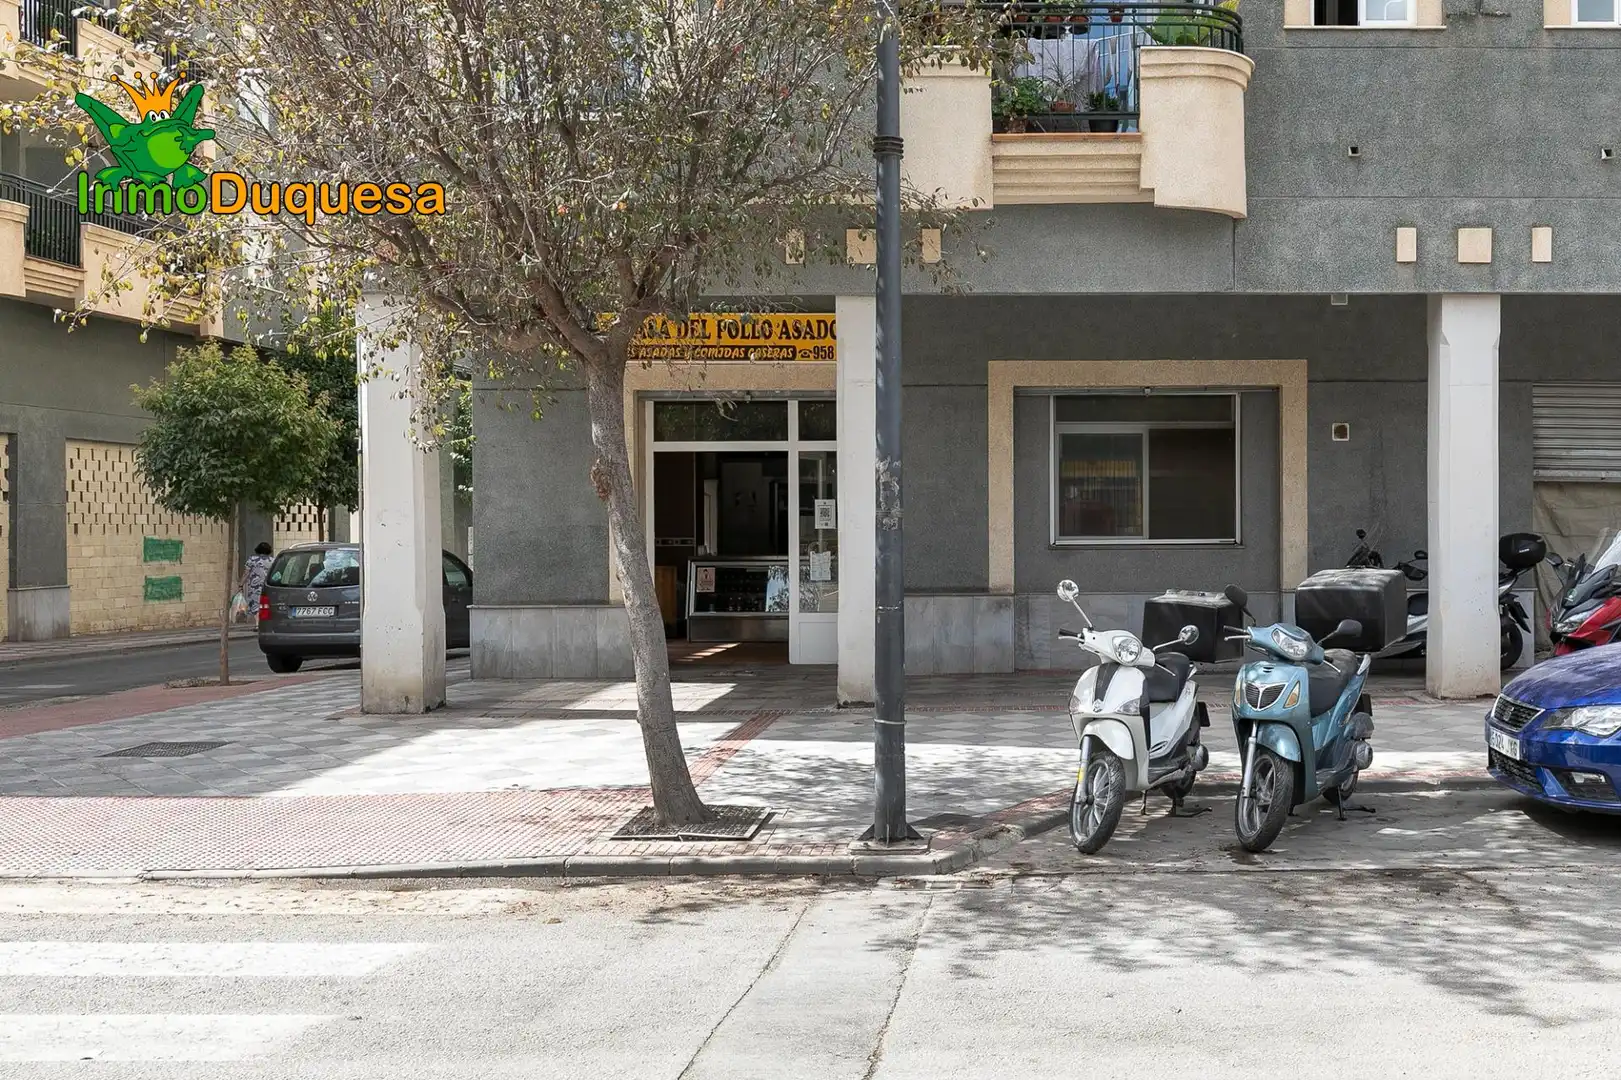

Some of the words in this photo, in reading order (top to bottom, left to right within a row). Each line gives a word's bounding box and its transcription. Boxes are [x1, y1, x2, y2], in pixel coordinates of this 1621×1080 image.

[677, 319, 711, 339] DEL
[716, 319, 773, 339] POLLO
[638, 347, 680, 358] ASADAS
[695, 346, 745, 358] COMIDAS
[748, 346, 793, 360] CASERAS
[813, 345, 835, 360] 958
